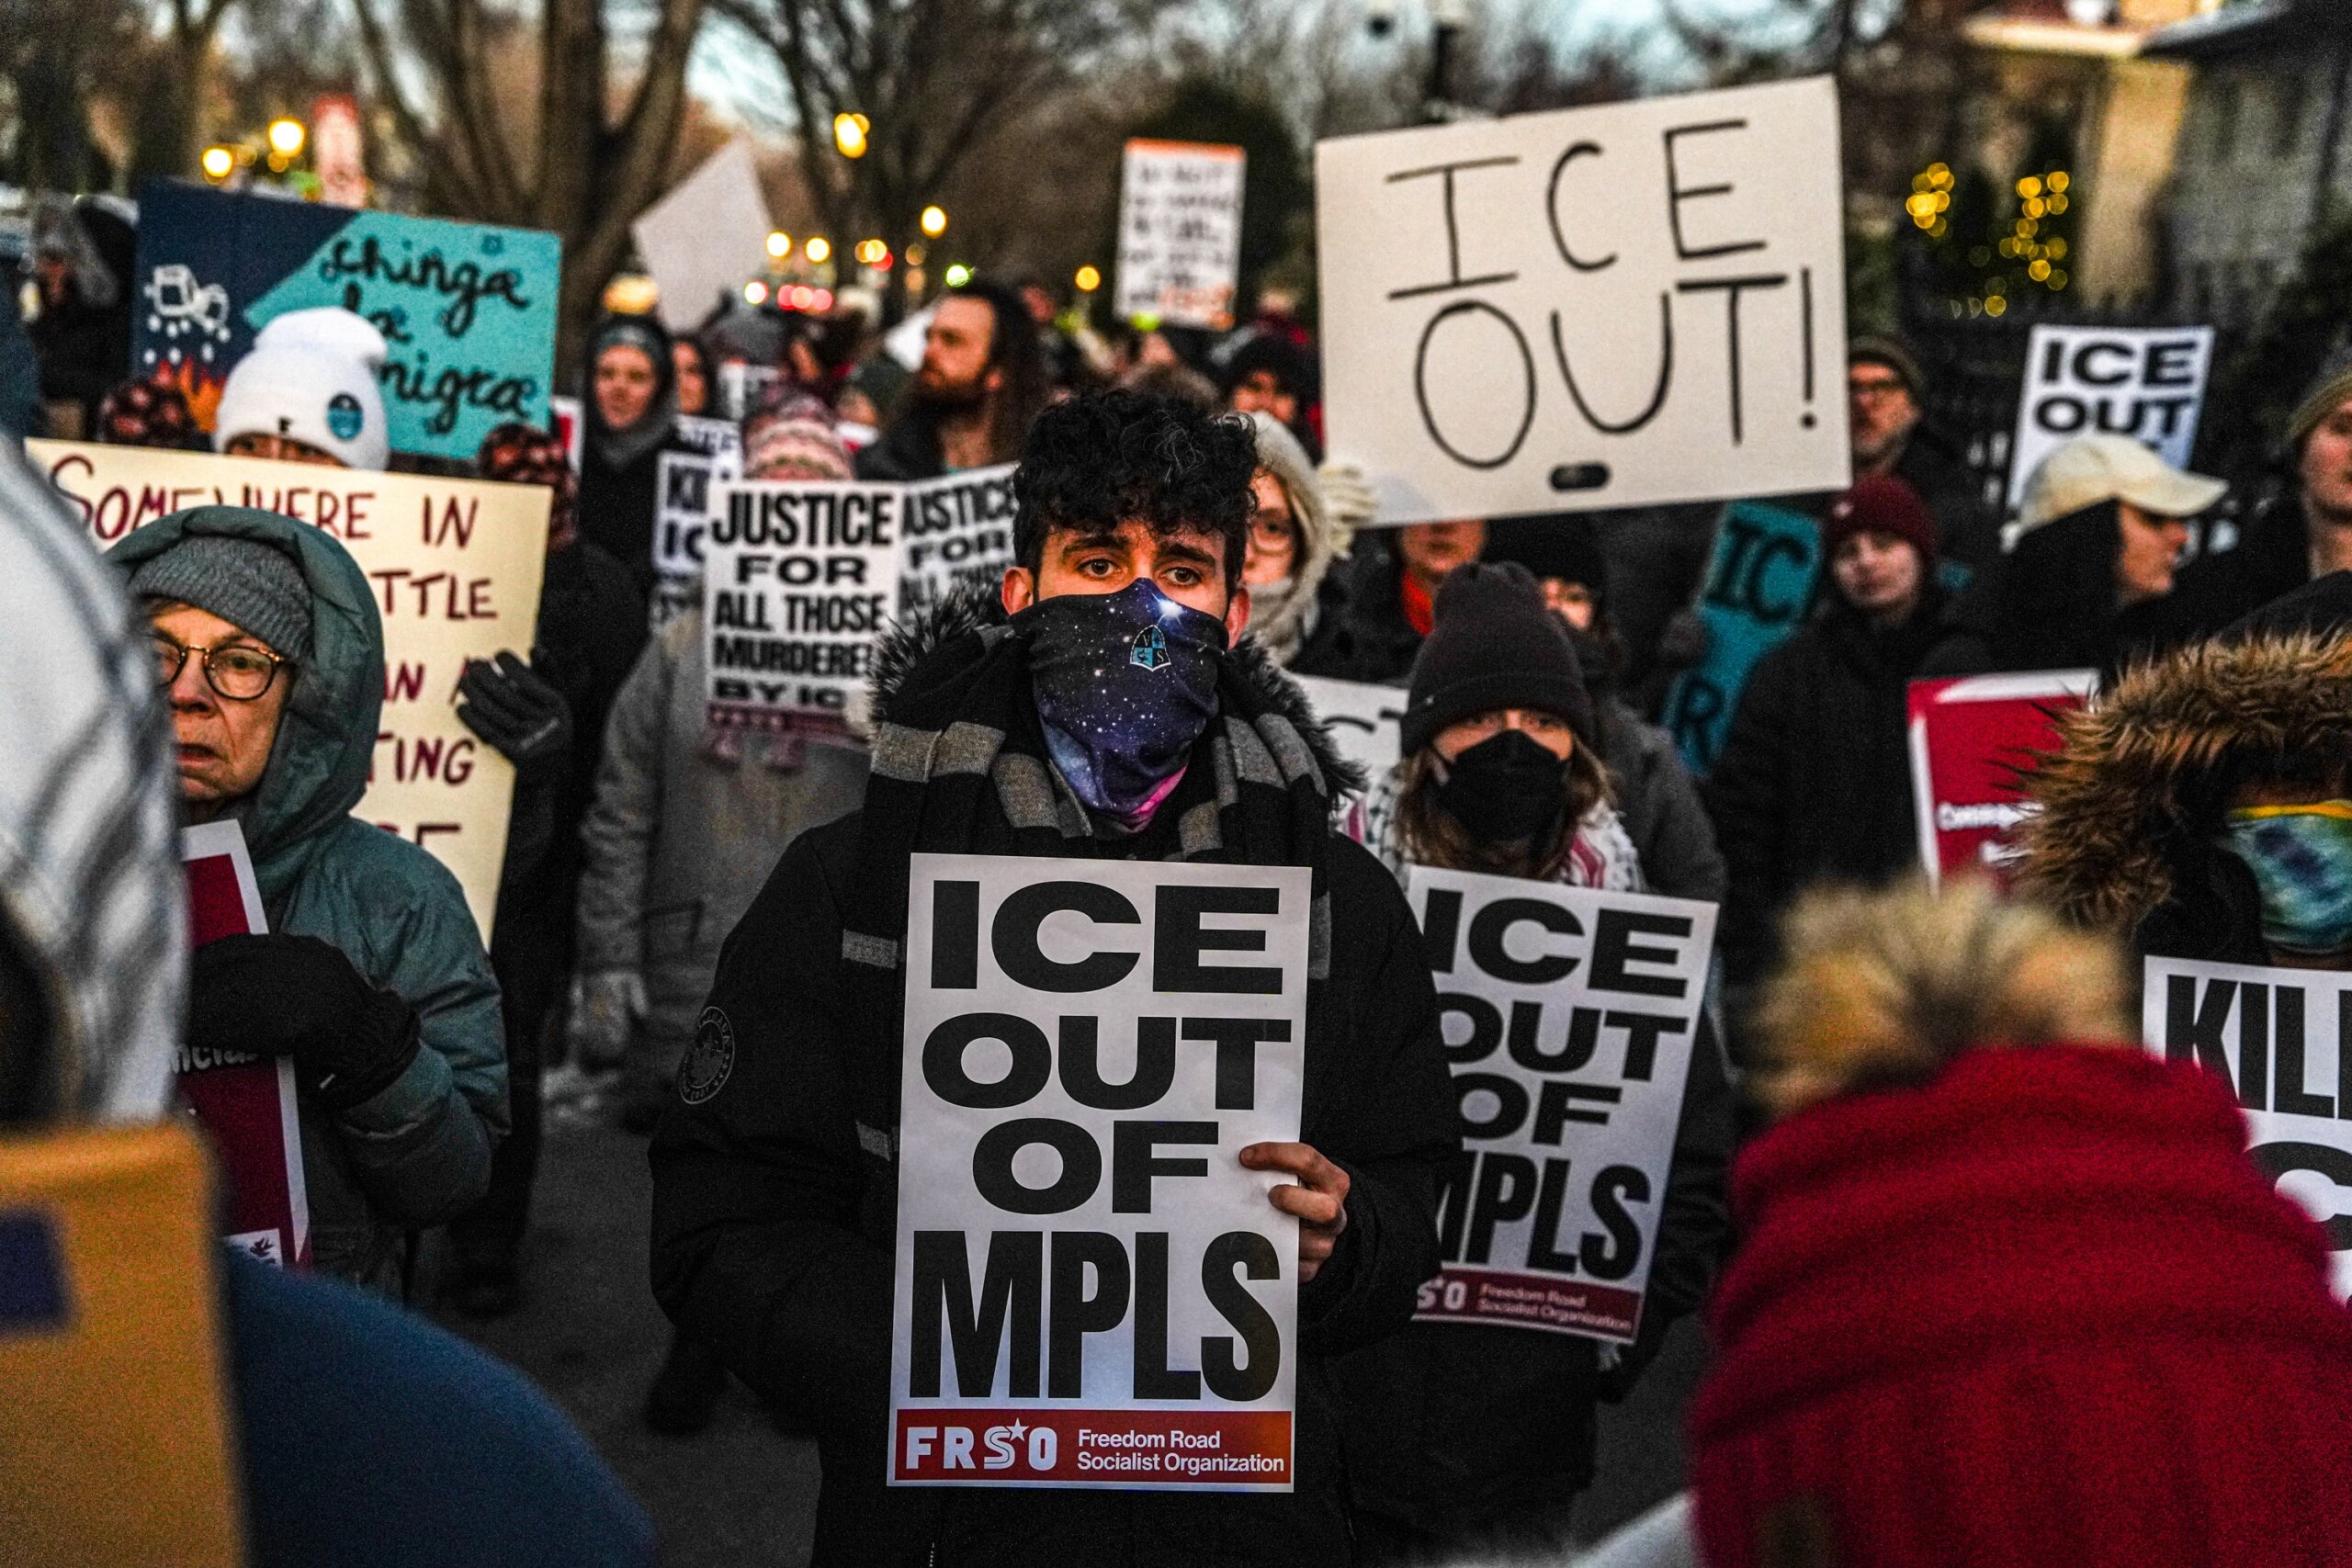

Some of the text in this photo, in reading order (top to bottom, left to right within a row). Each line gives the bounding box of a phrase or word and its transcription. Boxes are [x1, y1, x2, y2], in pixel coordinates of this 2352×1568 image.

[1386, 120, 1768, 299] ICE
[1416, 266, 1817, 470] OUT!
[2044, 340, 2197, 387] ICE
[2036, 397, 2193, 434] OUT
[423, 495, 479, 548] IN
[711, 491, 894, 547] JUSTICE
[737, 555, 867, 585] FOR
[910, 530, 1006, 570] FOR
[715, 591, 886, 634] ALL THOSE
[716, 678, 786, 704] BY
[931, 880, 1283, 994] ICE
[1423, 887, 1693, 998] ICE
[922, 1012, 1292, 1111] OUT
[2165, 974, 2352, 1120] KIL
[1453, 1072, 1623, 1146] OF
[972, 1117, 1219, 1215] OF
[910, 1230, 1281, 1402] MPLS
[906, 1418, 1057, 1471] FRSO
[1077, 1451, 1284, 1475] Socialist Organization
[1078, 1429, 1221, 1450] Freedom Road
